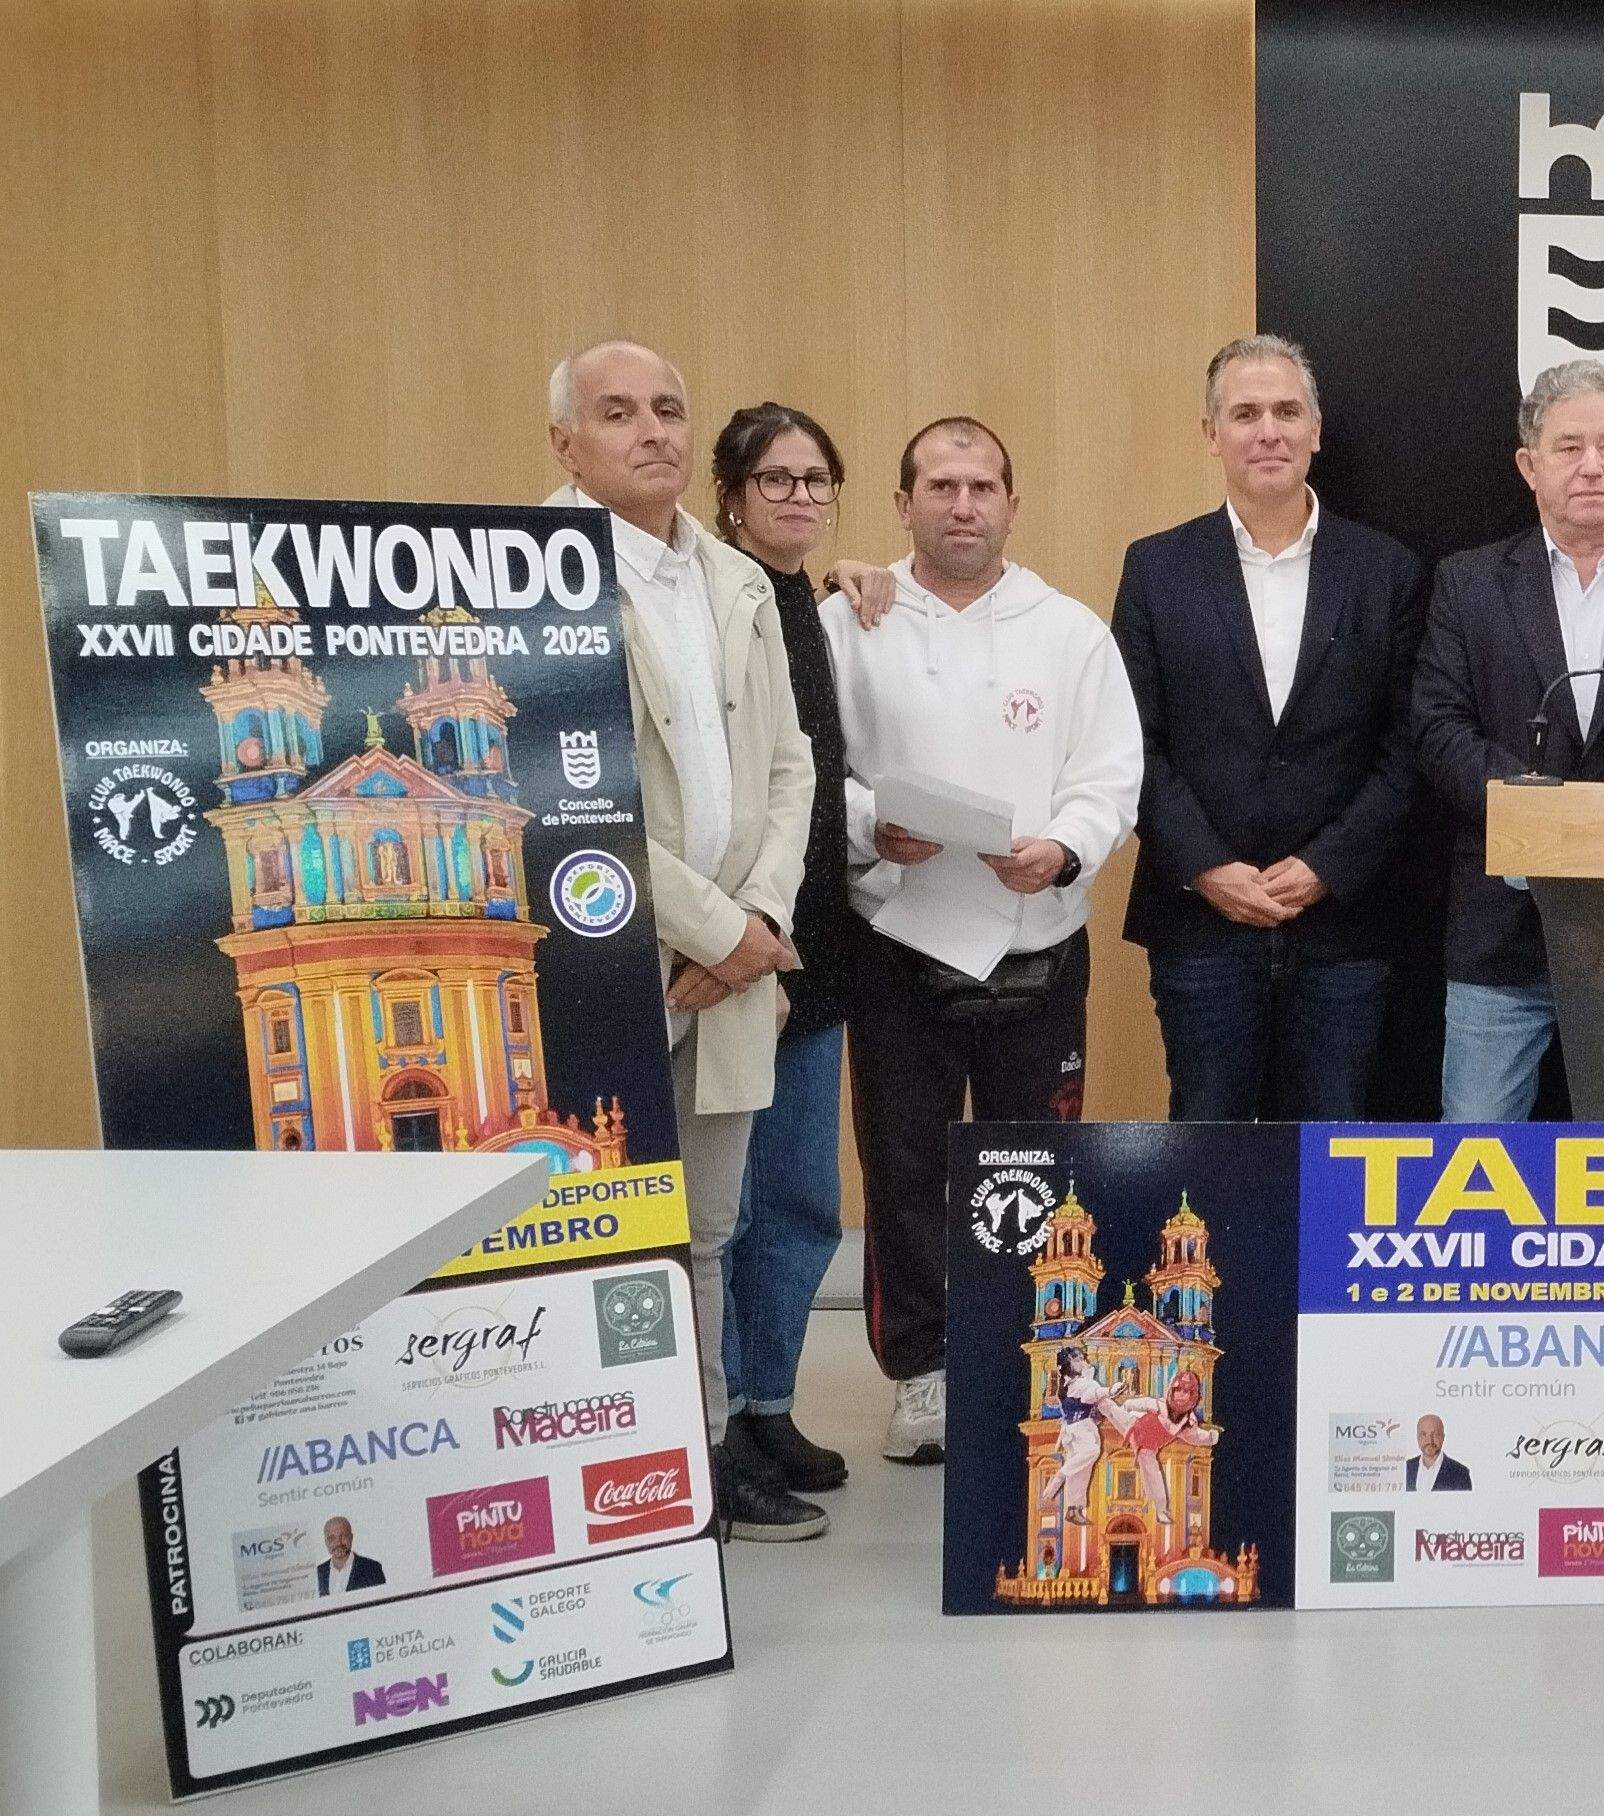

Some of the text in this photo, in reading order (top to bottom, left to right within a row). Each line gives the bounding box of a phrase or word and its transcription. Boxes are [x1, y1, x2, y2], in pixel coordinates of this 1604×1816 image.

[61, 518, 600, 611] TAEKWONDO
[78, 624, 611, 657] XXVII CIDADE PONTEVEDRA 2025
[85, 739, 189, 757] ORGANIZA:
[88, 764, 196, 811] CLUB TAEKWONDO
[541, 811, 634, 827] de Pontevedra
[558, 798, 614, 811] Concello
[153, 824, 198, 866] SPORT
[978, 1150, 1055, 1165] ORGANIZA:
[542, 1173, 675, 1209] DEPORTES
[970, 1168, 1057, 1208] CLUB TAEKWONDO
[1016, 1220, 1055, 1256] SPORT
[1346, 1231, 1486, 1268] XXVII
[1346, 1284, 1360, 1302] 1
[1371, 1287, 1389, 1303] e
[1396, 1284, 1415, 1303] 2
[1423, 1283, 1460, 1302] DE
[394, 1305, 547, 1372] sergraf
[1435, 1377, 1576, 1398] Sentir común
[493, 1400, 637, 1451] Maceira
[1335, 1425, 1378, 1439] MGS
[257, 1474, 374, 1508] Sentir común
[158, 1456, 188, 1616] PATROCINA
[240, 1538, 285, 1558] MGS
[1414, 1529, 1526, 1562] Maceira
[528, 1582, 592, 1606] DEPORTE
[530, 1597, 586, 1619] GALEGO
[188, 1629, 304, 1667] COLABORAN:
[374, 1628, 425, 1649] XUNTA
[375, 1635, 456, 1665] DE GALICIA
[538, 1647, 588, 1669] GALICIA
[539, 1656, 604, 1681] SAUDABLE
[241, 1680, 313, 1704] Deputación
